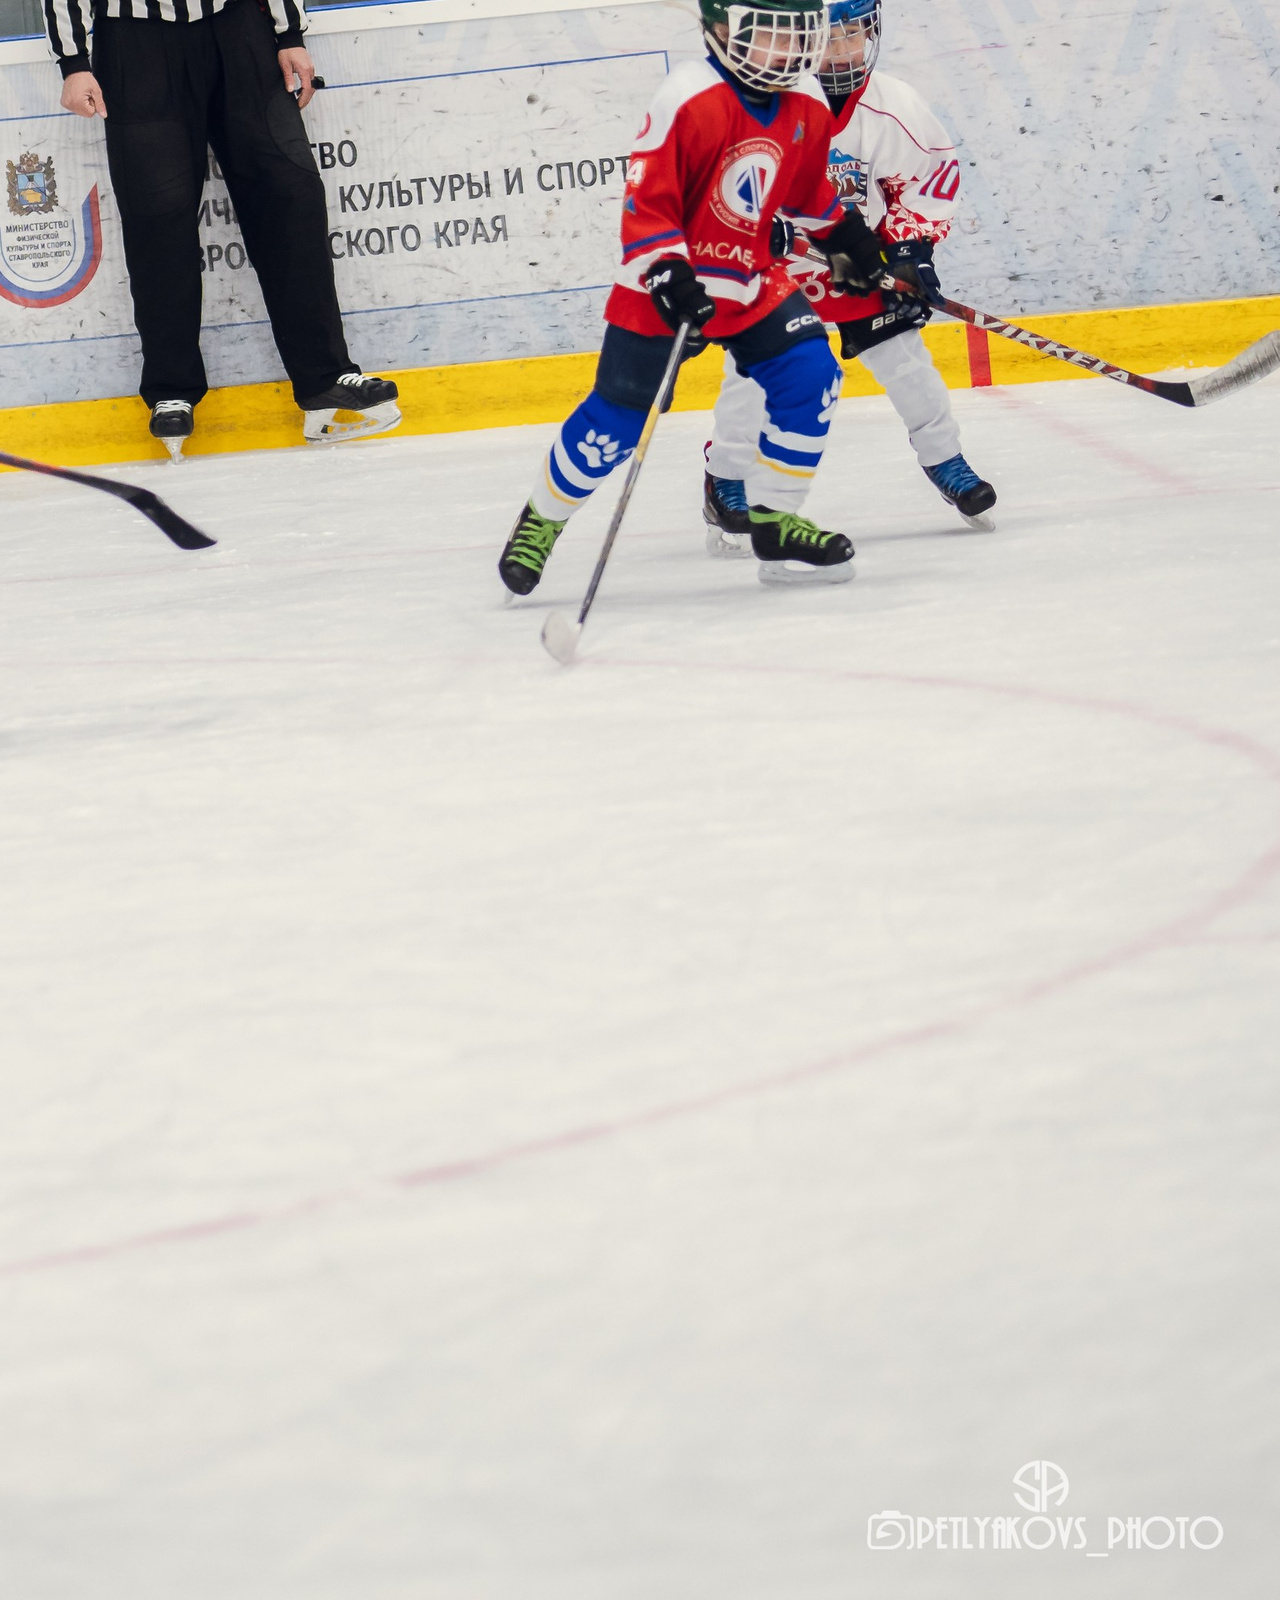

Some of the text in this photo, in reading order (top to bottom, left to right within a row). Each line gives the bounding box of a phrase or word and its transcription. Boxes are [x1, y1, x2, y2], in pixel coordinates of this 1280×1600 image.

[310, 139, 358, 170] ВО
[918, 159, 961, 202] 10
[338, 171, 492, 213] КУЛЬТУРЫ
[504, 167, 524, 196] И
[5, 220, 69, 233] МИНИСТЕРСТВО
[433, 214, 509, 249] КРАЯ
[16, 231, 60, 242] ФИЗИЧЕСКОЙ
[6, 243, 40, 252] КУЛЬТУРЫ
[46, 240, 72, 249] СПОРТА
[8, 250, 71, 262] СТАВРОПОЛЬСКОГО
[31, 261, 49, 269] КРАЯ
